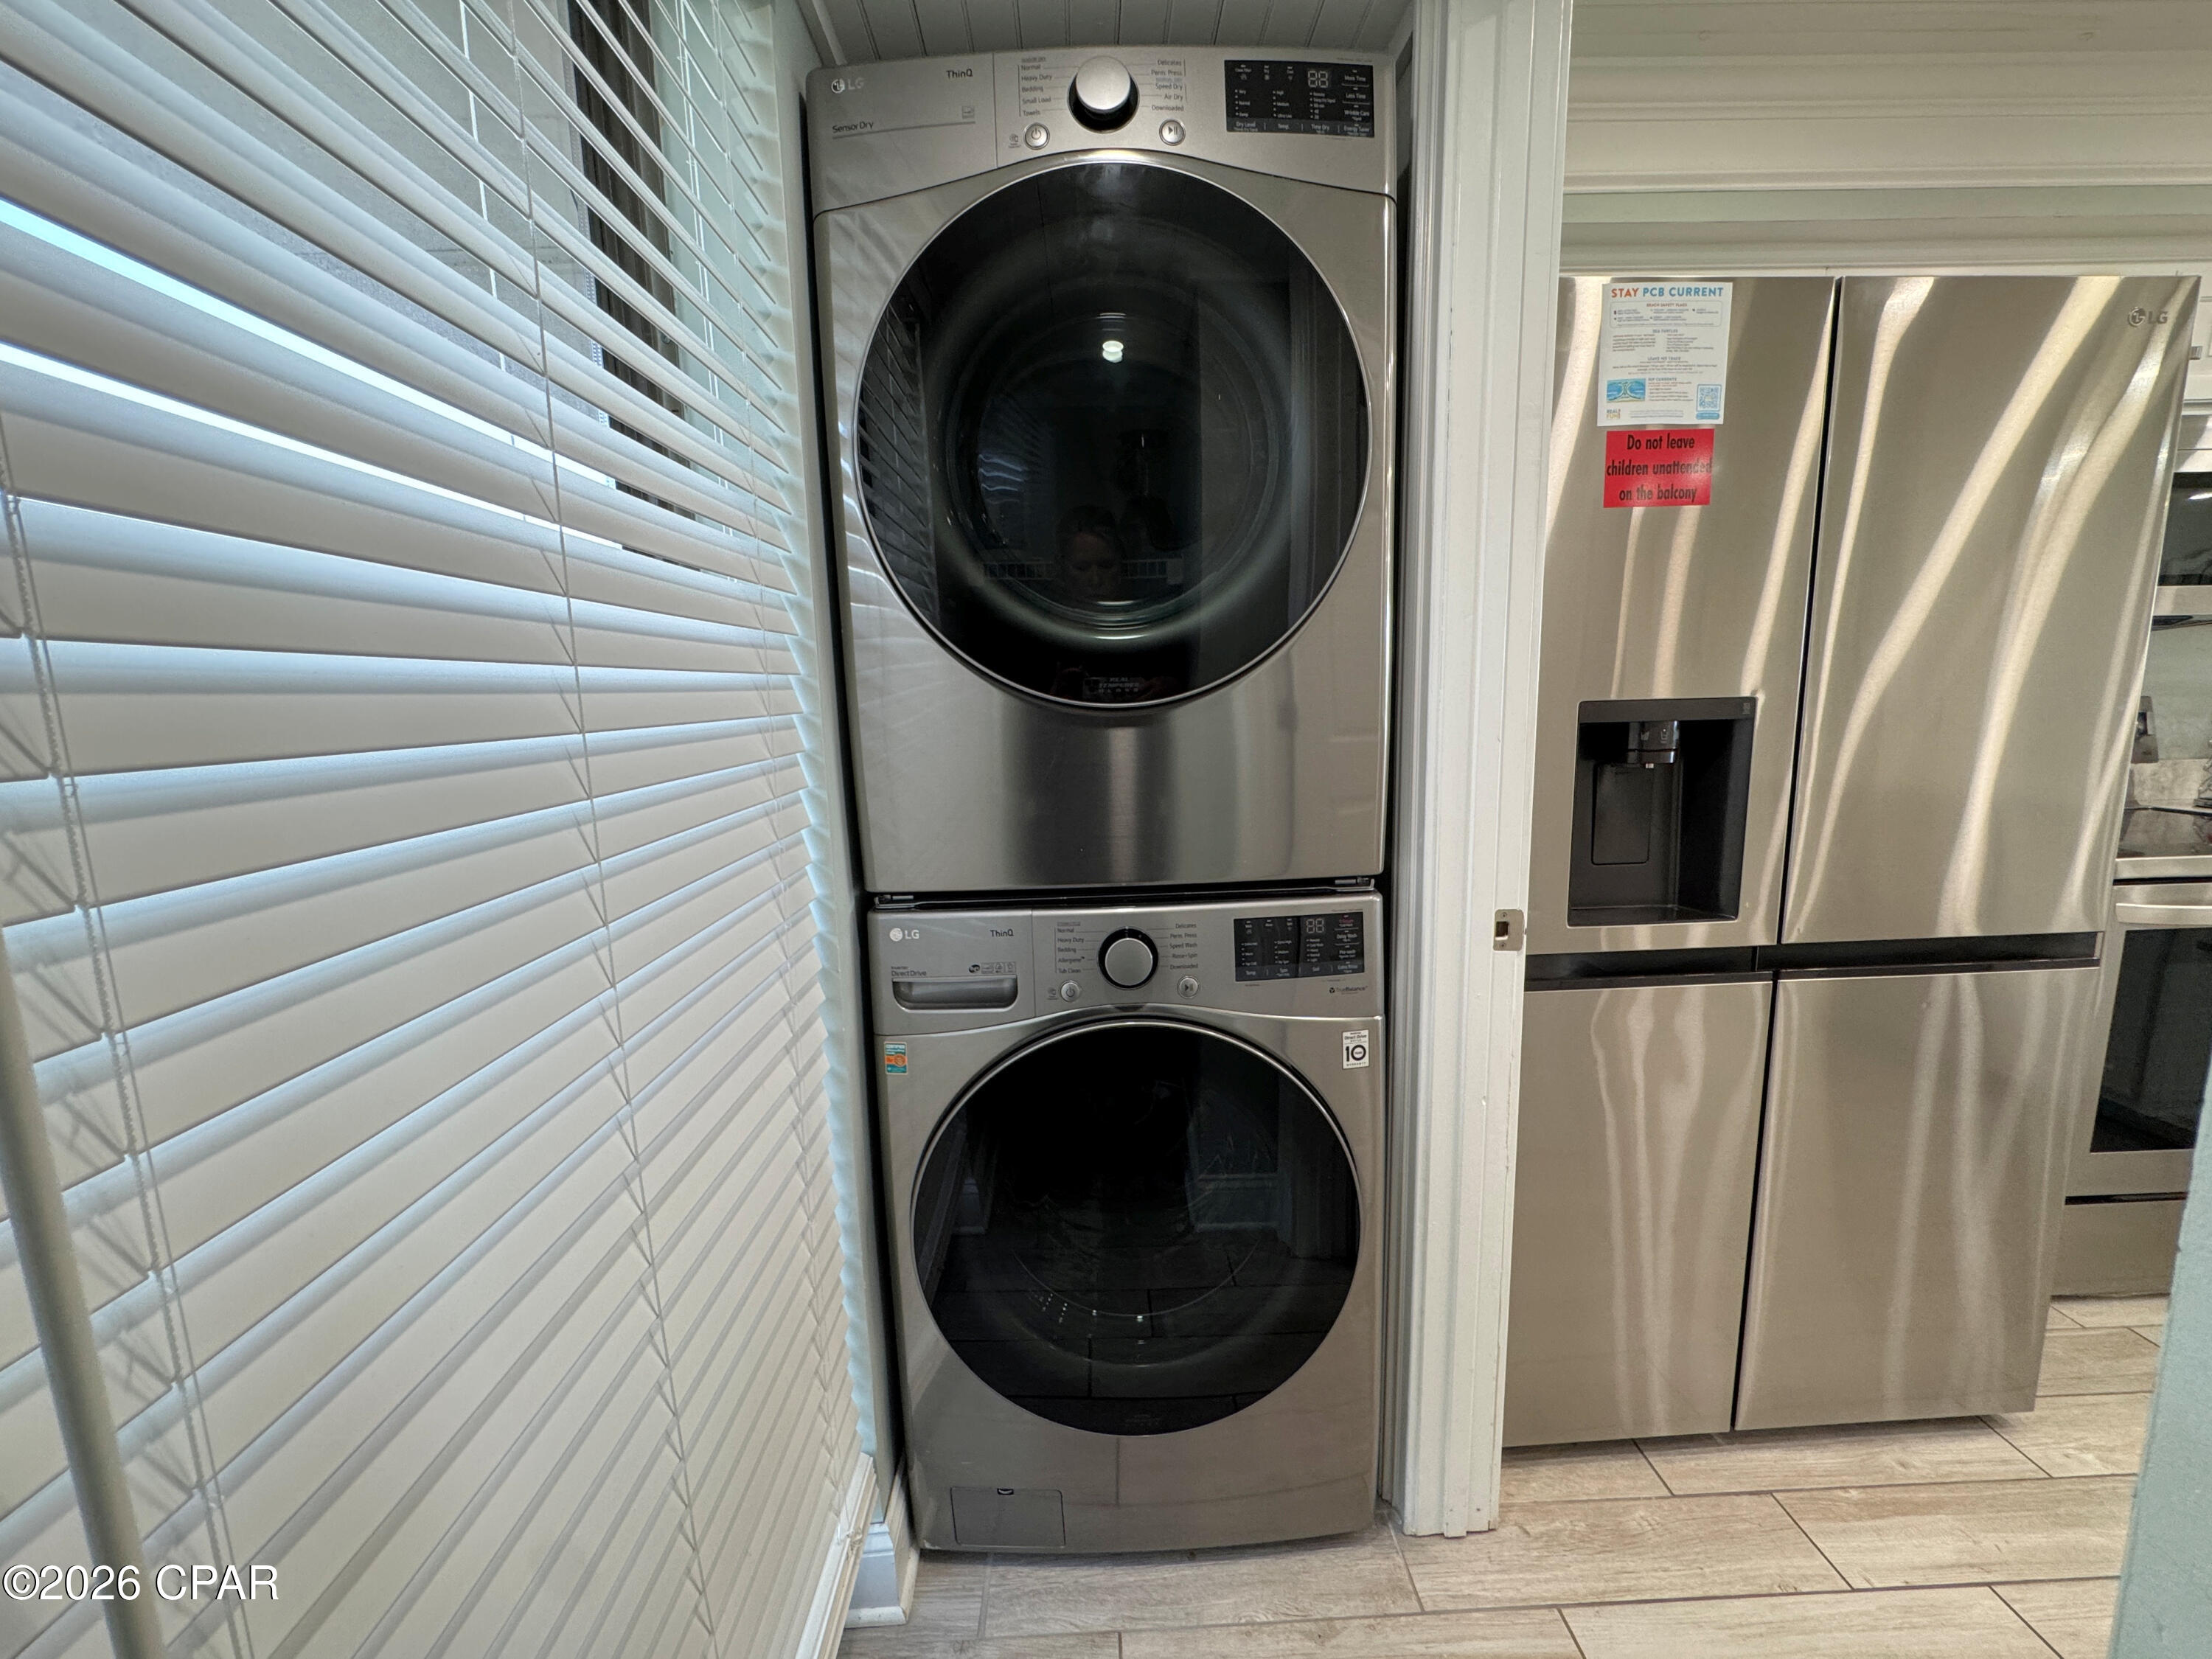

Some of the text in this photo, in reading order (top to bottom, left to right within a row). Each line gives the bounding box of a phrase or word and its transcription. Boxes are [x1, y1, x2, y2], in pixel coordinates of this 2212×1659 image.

[947, 69, 973, 79] ThinQ
[848, 77, 864, 90] LG
[832, 121, 874, 133] Sensor Dry
[1611, 287, 1724, 299] STAY PCB CURRENT
[1627, 433, 1695, 450] Do not leave
[1607, 457, 1713, 476] children unattended
[1619, 484, 1697, 503] on the balcony
[905, 930, 919, 940] LG
[990, 929, 1014, 937] ThinQ
[1346, 1044, 1366, 1062] 10
